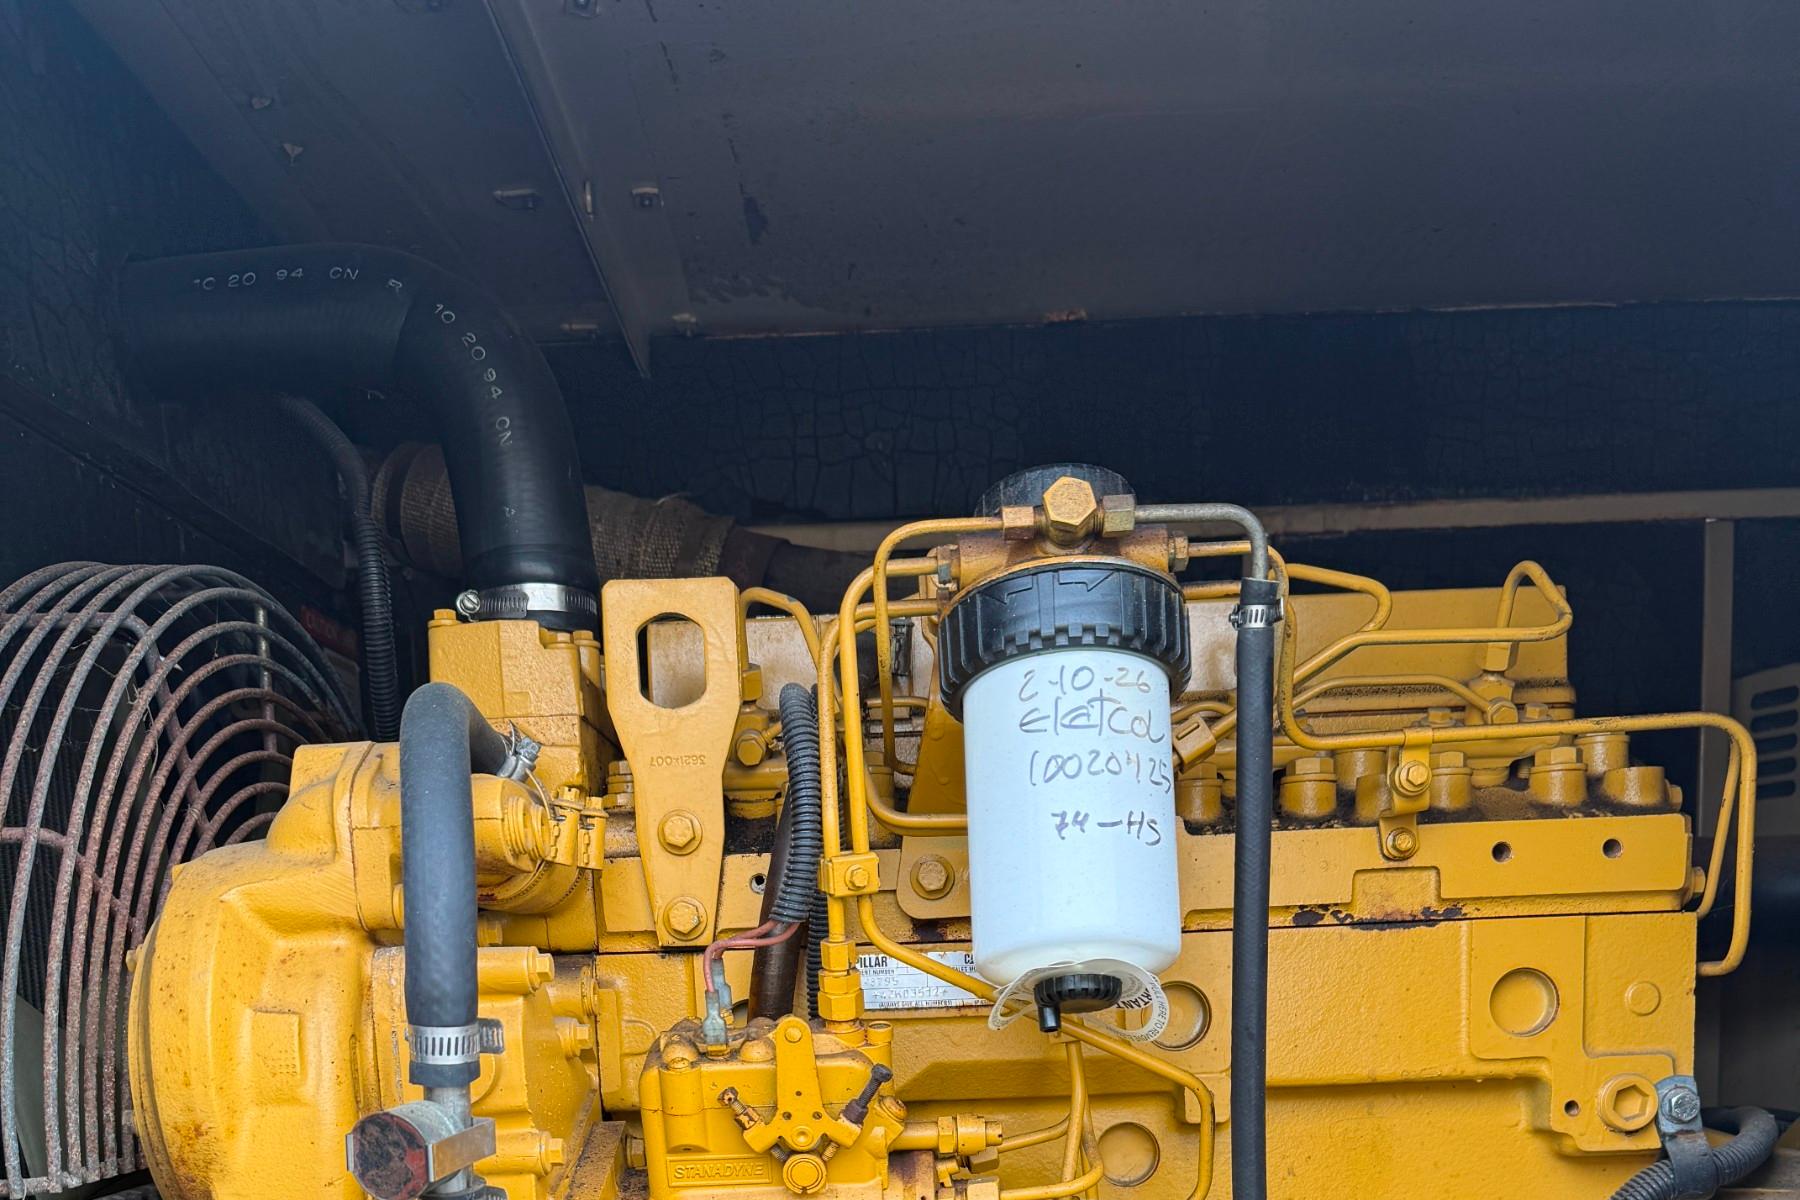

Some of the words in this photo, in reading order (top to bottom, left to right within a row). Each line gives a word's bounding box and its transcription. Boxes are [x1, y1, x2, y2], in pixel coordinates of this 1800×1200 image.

[227, 271, 257, 288] 20
[328, 266, 360, 281] CN
[460, 332, 487, 362] 20
[673, 1162, 764, 1181] STANADYNE
